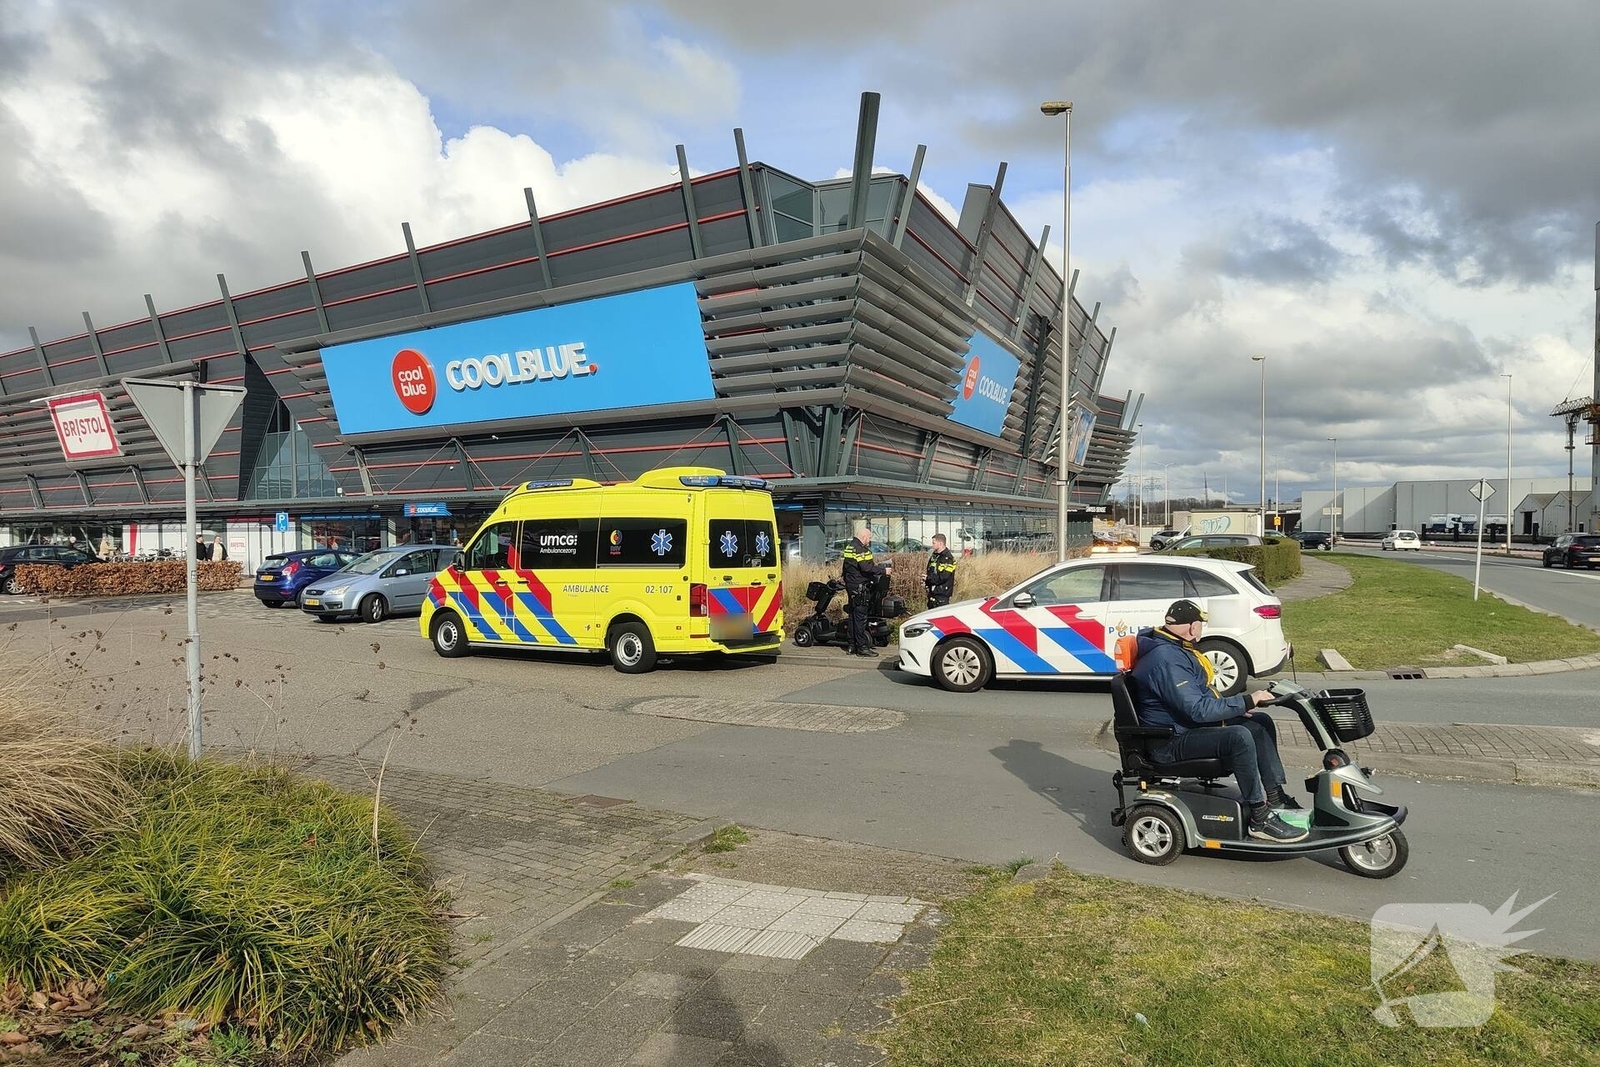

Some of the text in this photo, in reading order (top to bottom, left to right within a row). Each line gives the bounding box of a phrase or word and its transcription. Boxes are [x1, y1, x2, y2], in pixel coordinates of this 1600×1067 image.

[398, 366, 424, 382] cool
[400, 382, 427, 397] blue
[62, 416, 106, 443] BRISTOL
[540, 547, 577, 555] Ambulancezorg
[562, 585, 609, 593] AMBULANCE
[645, 586, 673, 594] 02-107
